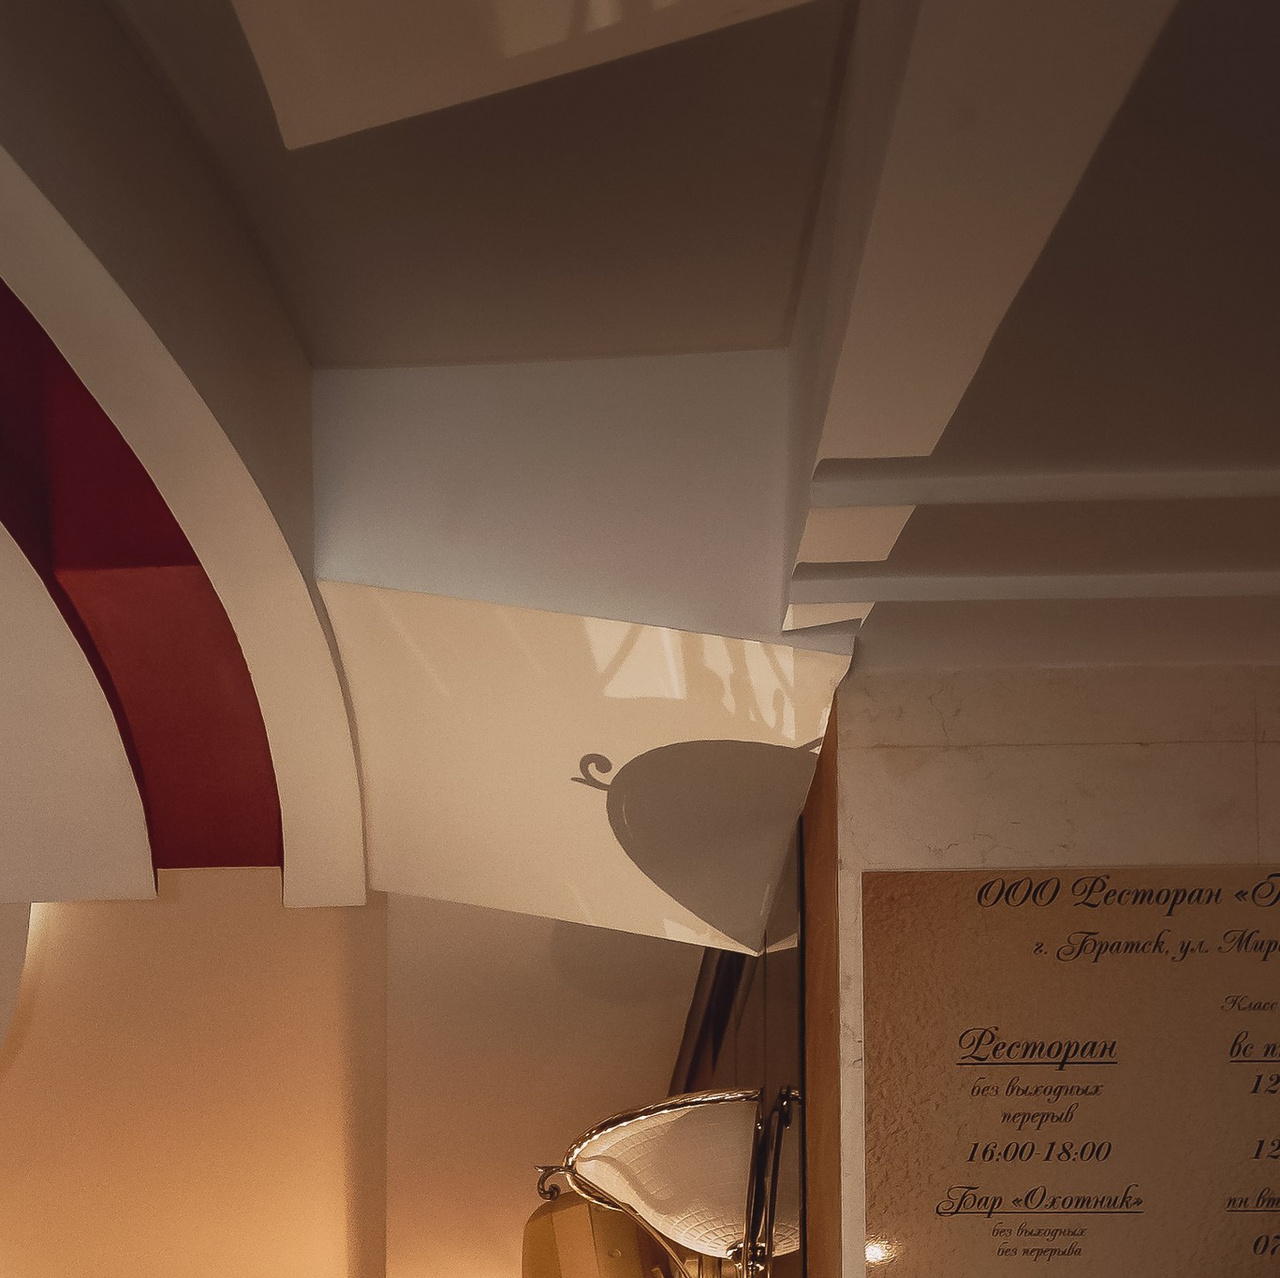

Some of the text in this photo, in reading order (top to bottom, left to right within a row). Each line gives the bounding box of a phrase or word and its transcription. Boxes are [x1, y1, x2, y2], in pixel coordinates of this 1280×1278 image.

[976, 876, 1061, 908] ООО
[1071, 873, 1223, 917] Ресторан
[1033, 940, 1049, 956] г.
[1055, 928, 1170, 964] Братск,
[1171, 938, 1210, 963] ул.
[956, 1025, 1119, 1071] Ресторан
[1229, 1030, 1258, 1060] вс
[970, 1076, 1105, 1103] без выходных
[1000, 1103, 1080, 1131] перерыв
[964, 1140, 1114, 1164] 16:00-18:00
[935, 1183, 1144, 1219] Бар «Охотник»
[992, 1222, 1088, 1243] без выходных
[997, 1243, 1083, 1262] без перерыва
